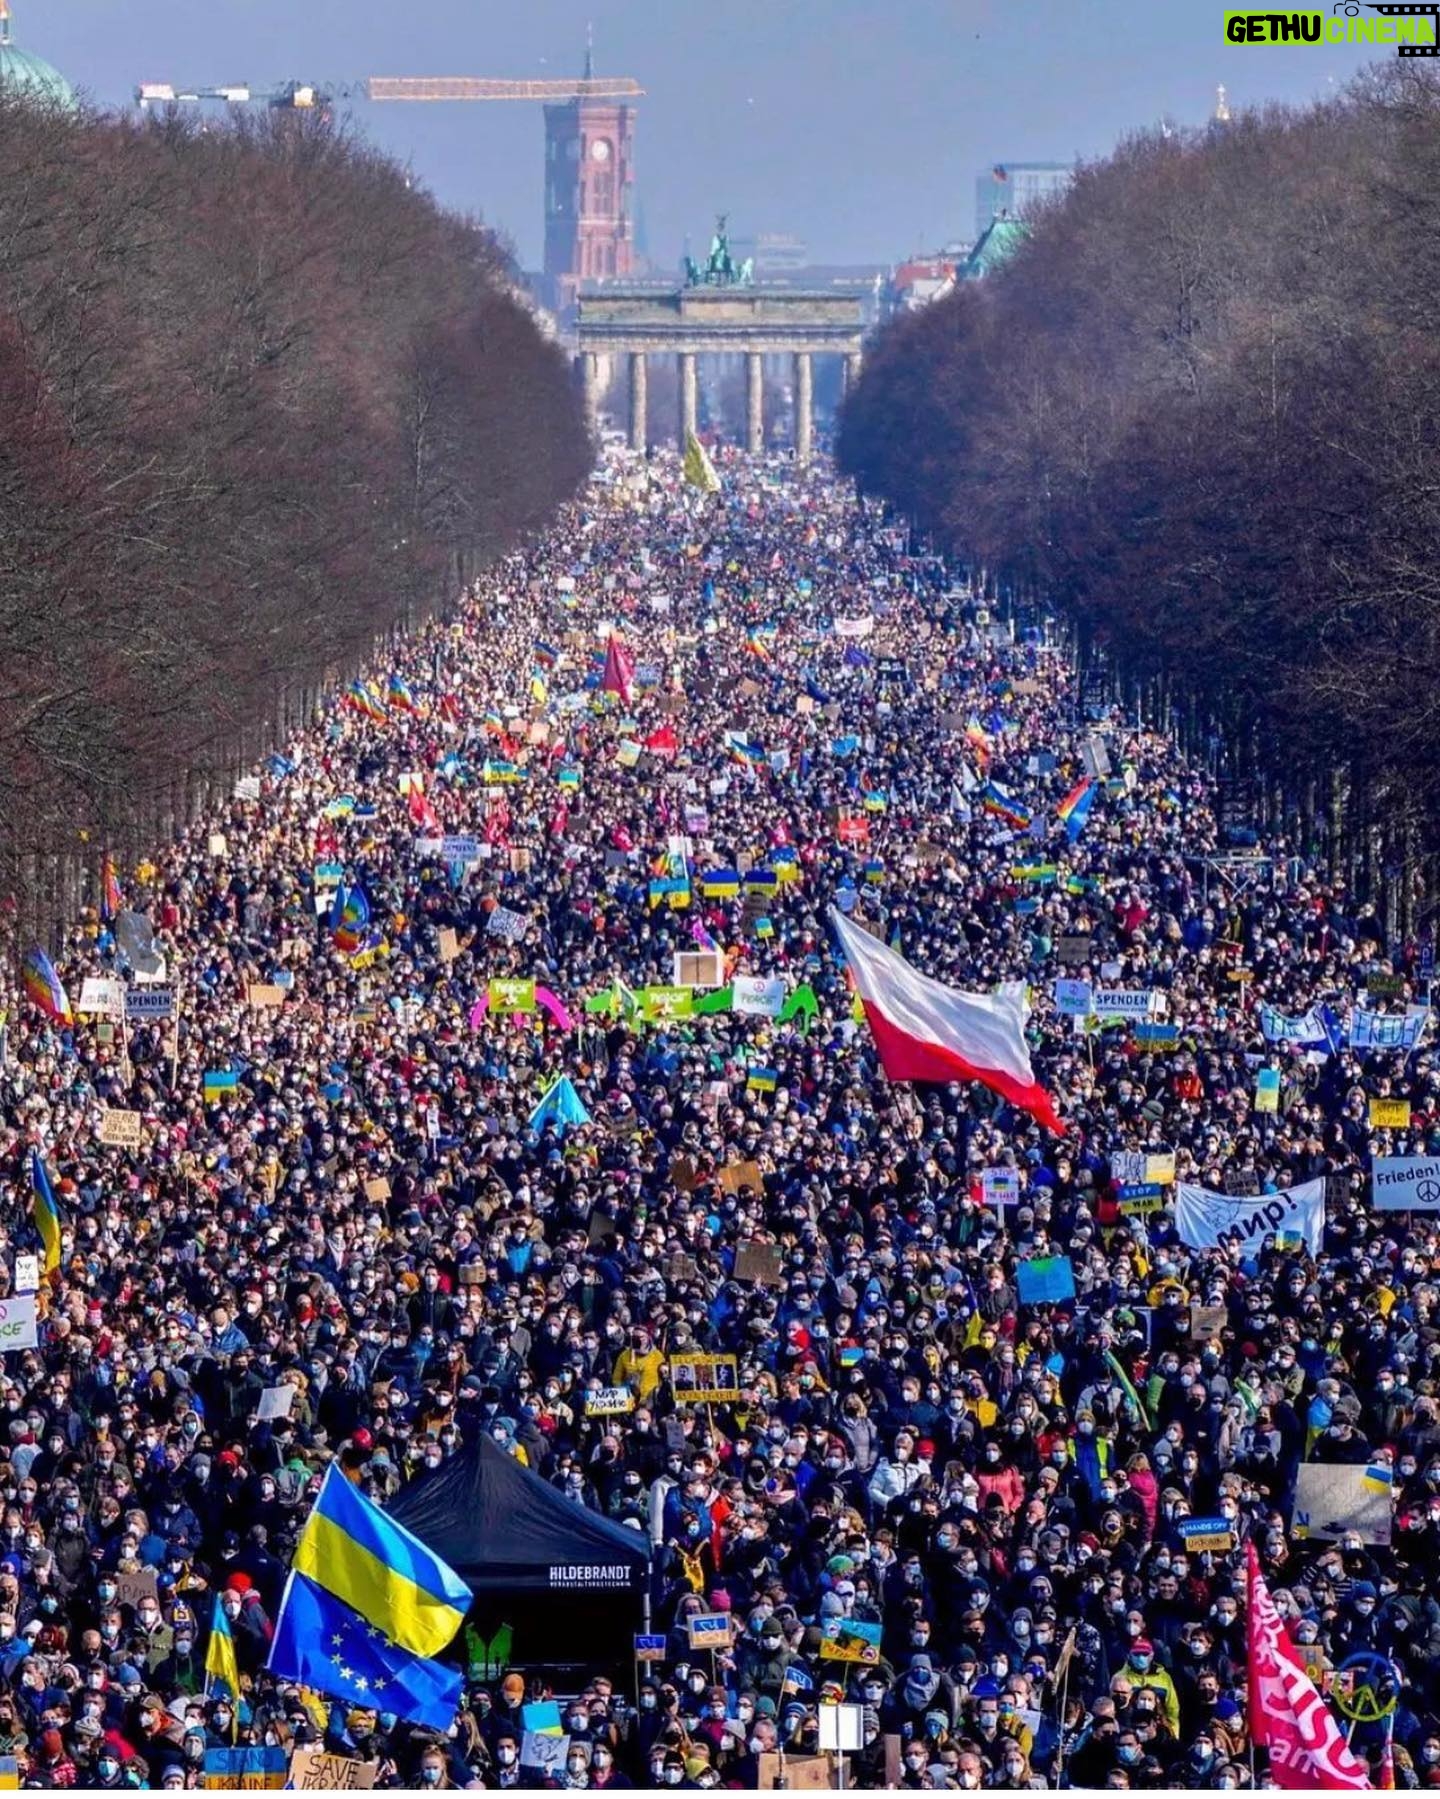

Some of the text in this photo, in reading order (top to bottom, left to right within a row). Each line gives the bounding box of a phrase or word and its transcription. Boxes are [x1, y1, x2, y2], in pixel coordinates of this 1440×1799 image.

[127, 995, 171, 1007] SPENDEN
[1096, 994, 1149, 1007] SPENDEN
[1376, 1162, 1440, 1186] Frieden!
[1123, 1186, 1152, 1197] STOP
[550, 1566, 631, 1580] HILDEBRANDT
[304, 1754, 360, 1783] SAVE
